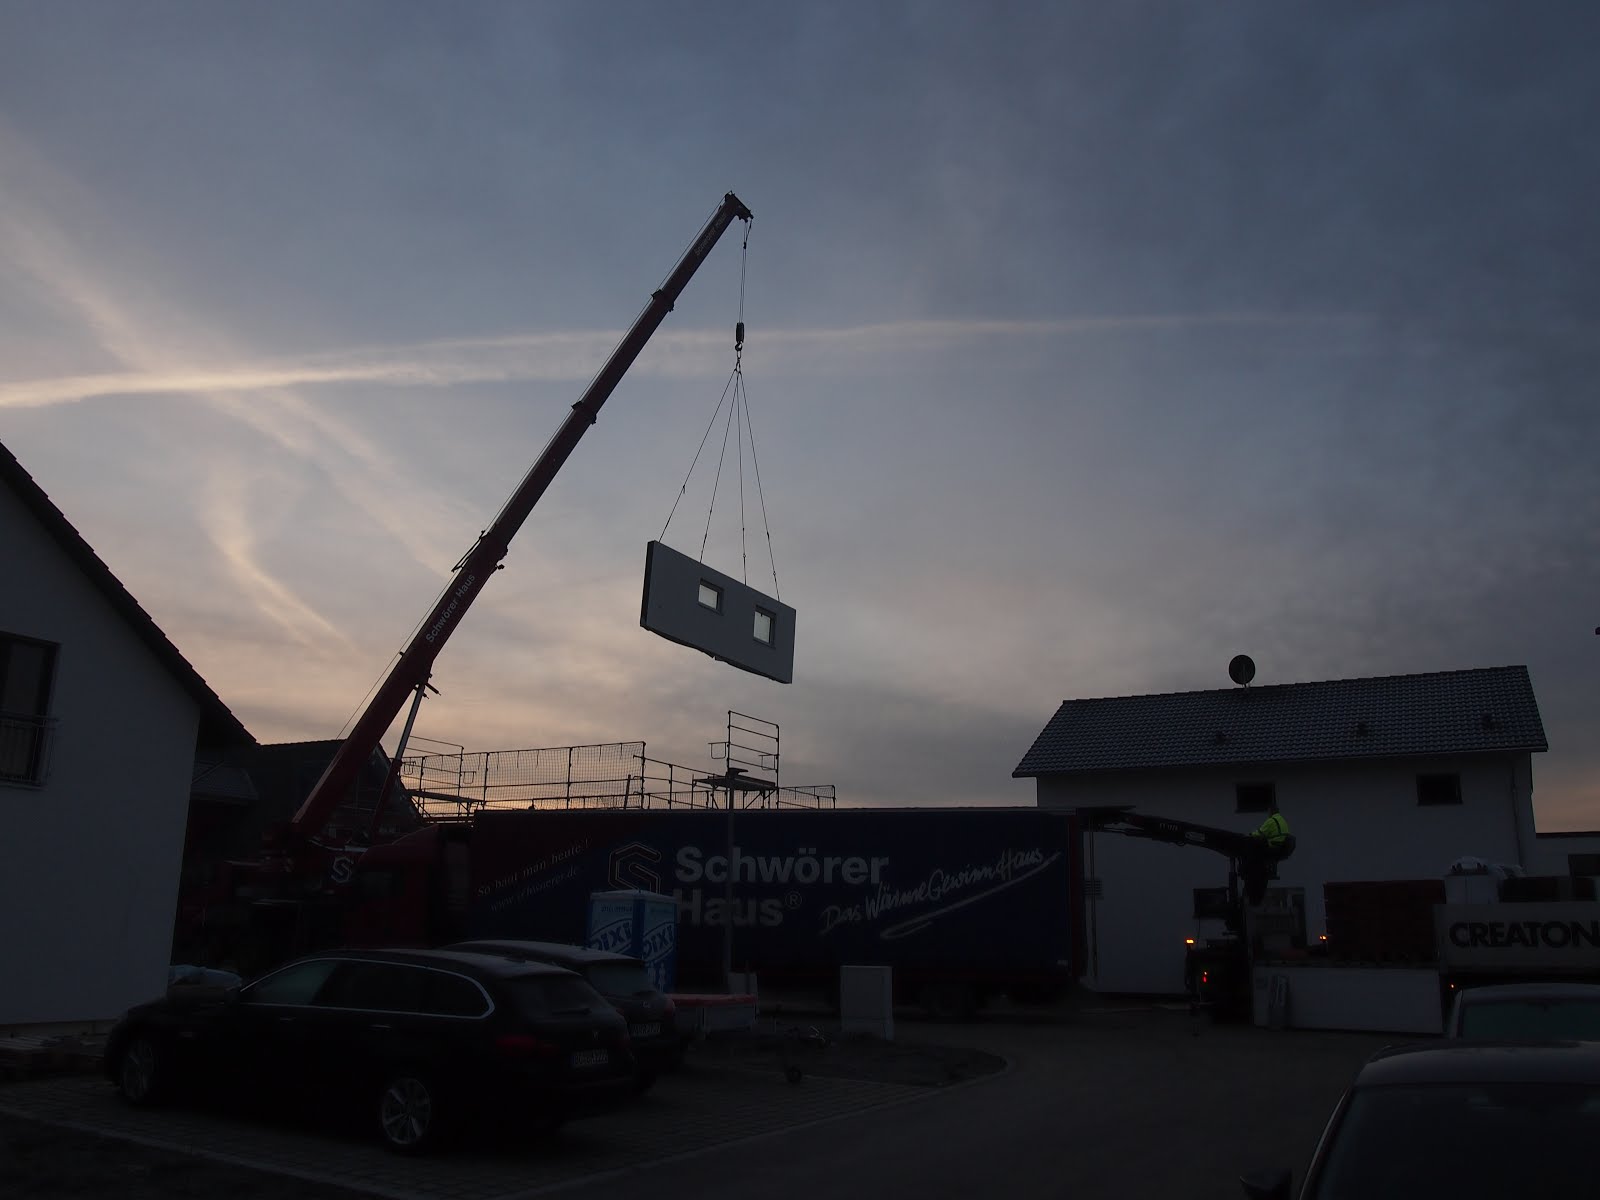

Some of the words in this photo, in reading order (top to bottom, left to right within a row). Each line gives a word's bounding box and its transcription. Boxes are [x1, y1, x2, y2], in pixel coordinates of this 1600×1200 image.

[425, 598, 458, 643] Schwörer
[455, 574, 476, 598] Haus
[675, 845, 889, 884] Schwörer
[816, 904, 864, 936] Das
[1449, 920, 1600, 949] CREATON
